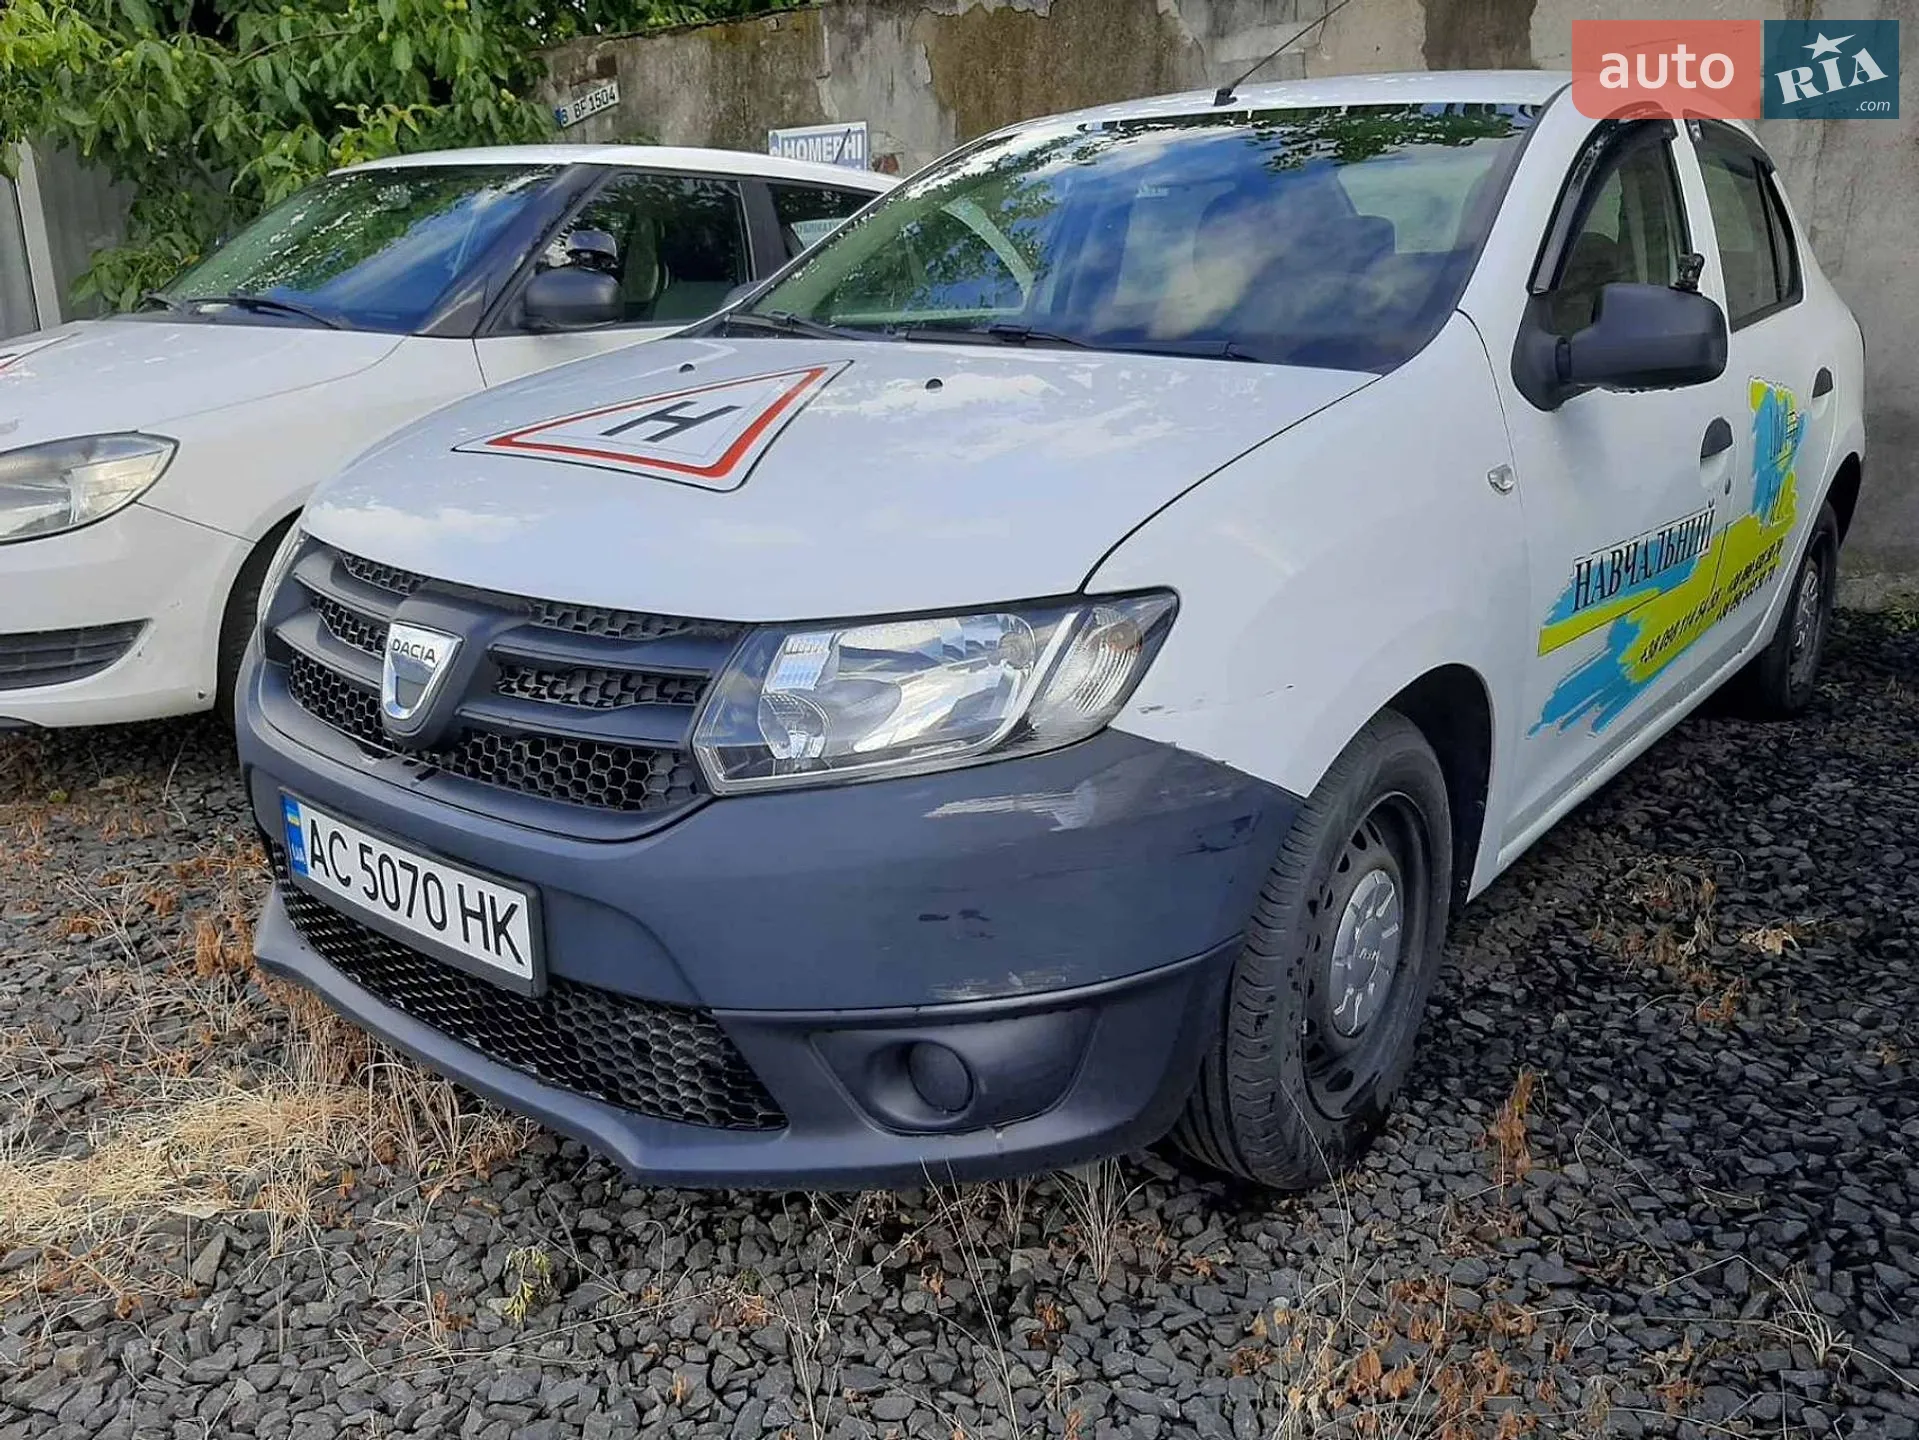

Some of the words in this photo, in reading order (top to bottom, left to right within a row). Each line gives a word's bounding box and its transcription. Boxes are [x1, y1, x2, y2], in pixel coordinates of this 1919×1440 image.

[589, 86, 616, 111] 1504
[1571, 500, 1716, 613] НАВЧАЛЬНИЙ
[391, 638, 436, 663] DACIA
[310, 818, 351, 887] AC
[358, 842, 447, 931] 5070
[457, 883, 525, 966] HK
